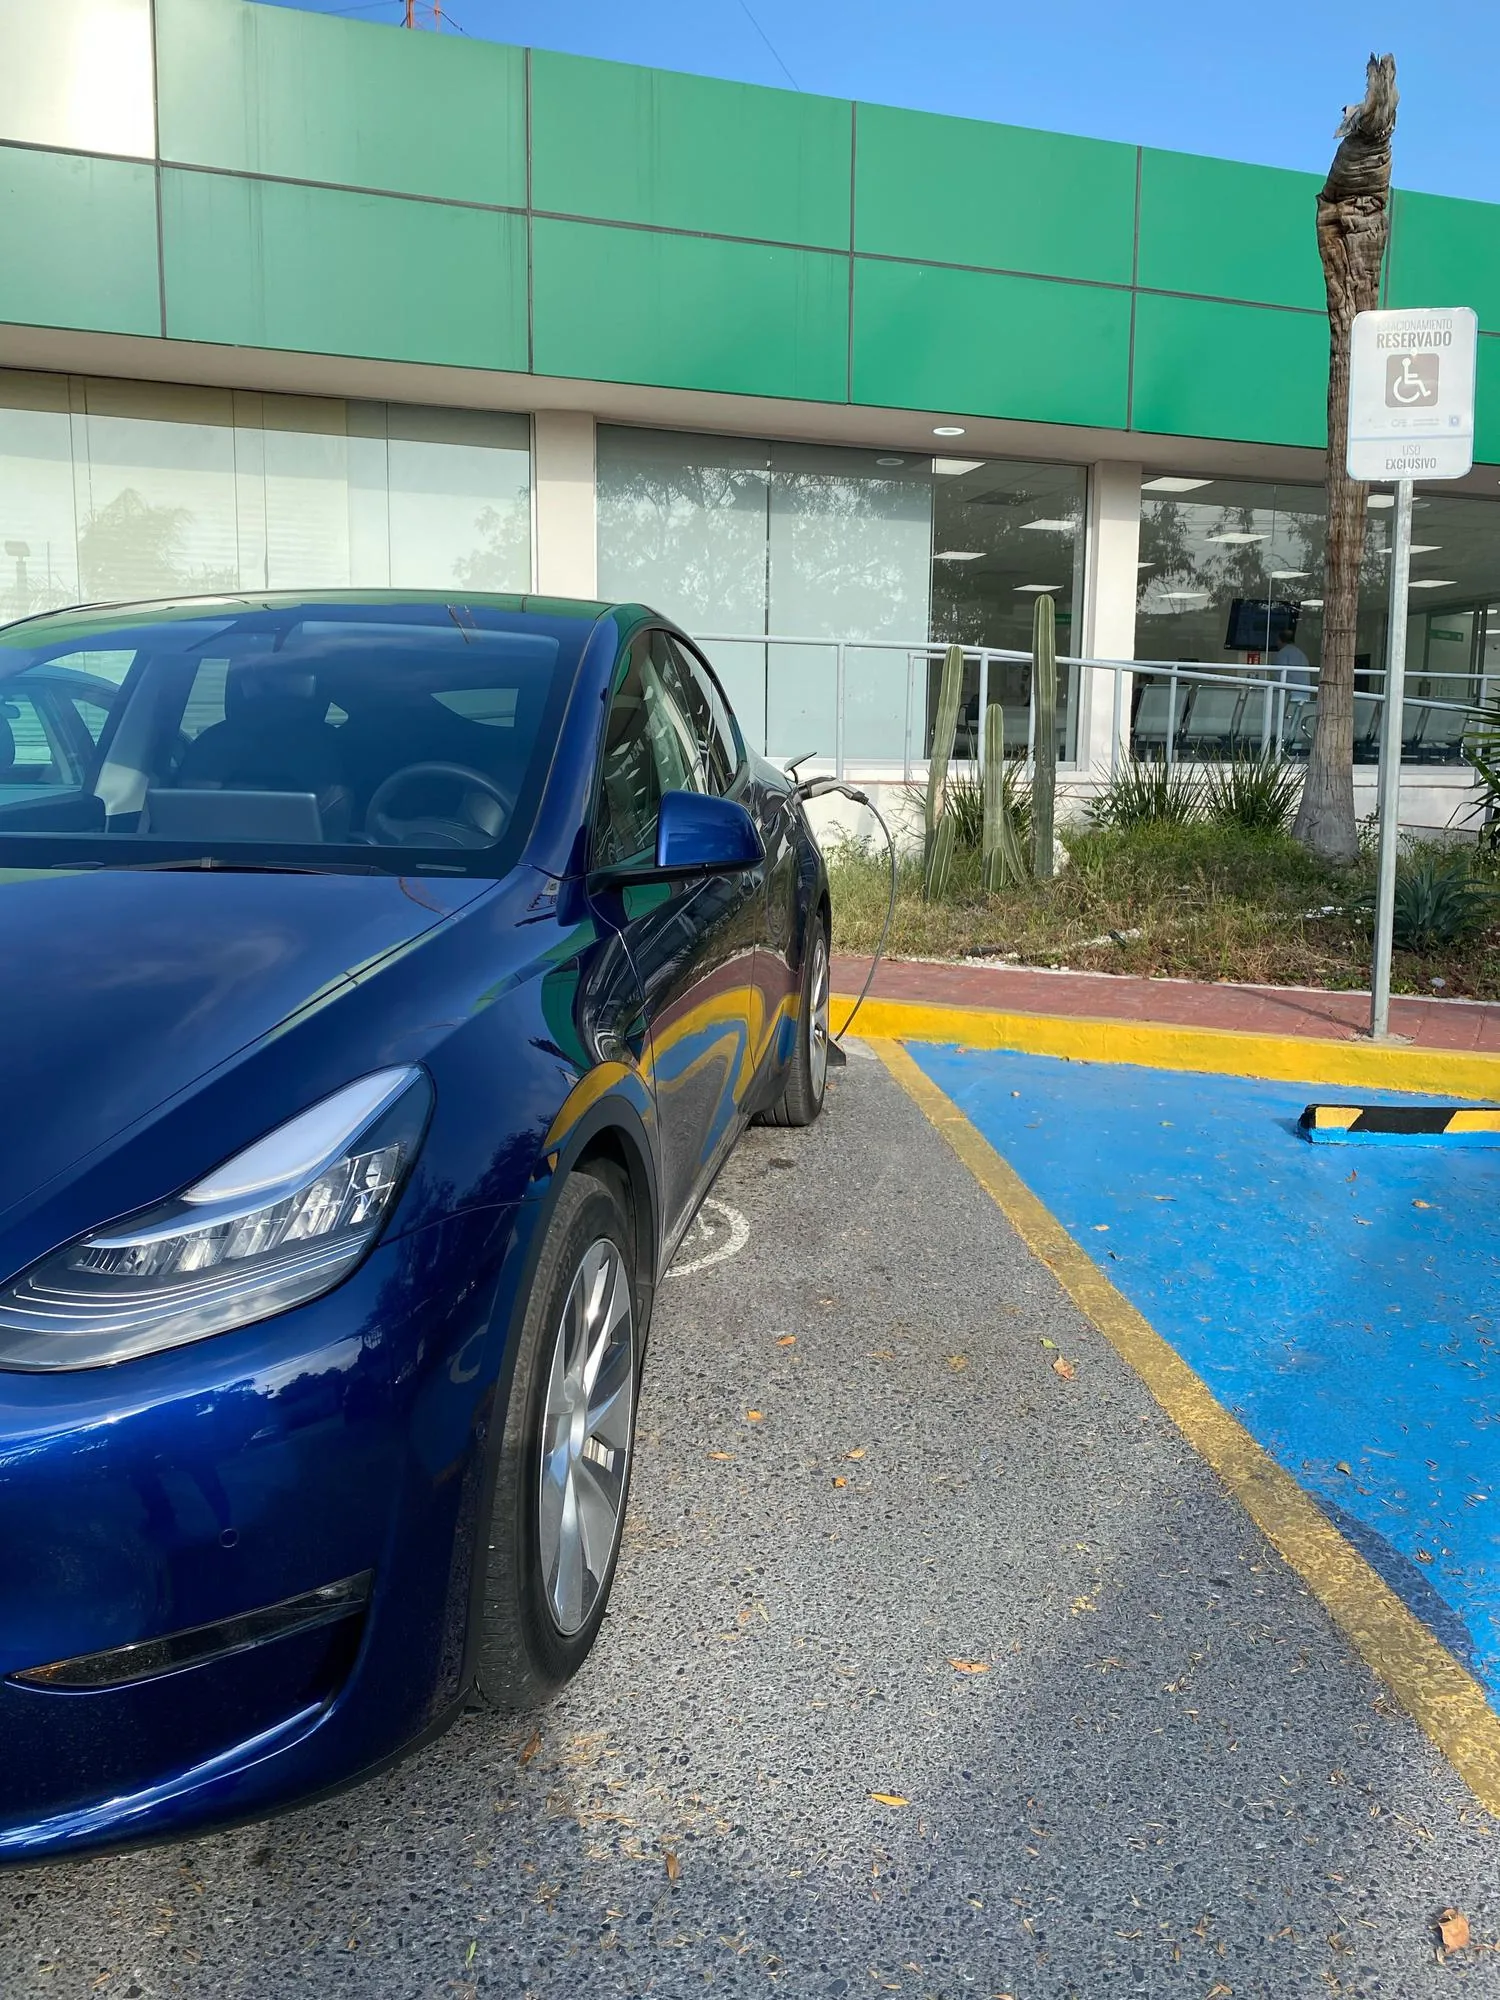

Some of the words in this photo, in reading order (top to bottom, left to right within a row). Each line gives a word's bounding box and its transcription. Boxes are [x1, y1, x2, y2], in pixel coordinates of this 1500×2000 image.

[1376, 331, 1452, 348] RESERVADO
[1402, 444, 1421, 456] USO
[1385, 457, 1437, 470] EXCLUSIVO
